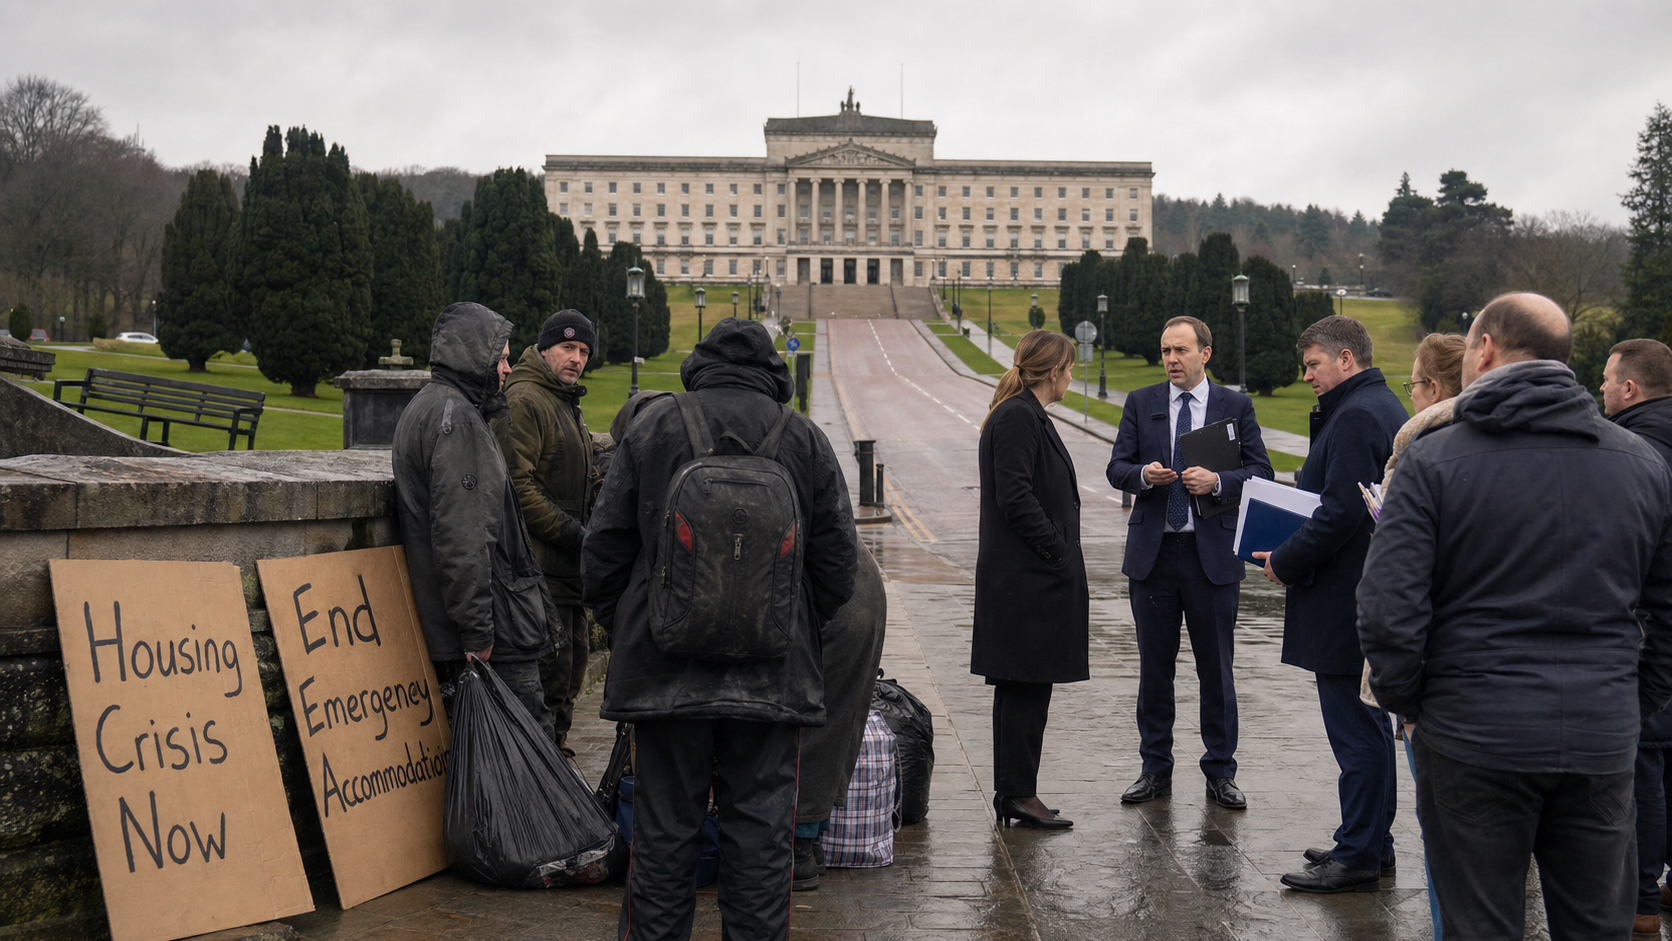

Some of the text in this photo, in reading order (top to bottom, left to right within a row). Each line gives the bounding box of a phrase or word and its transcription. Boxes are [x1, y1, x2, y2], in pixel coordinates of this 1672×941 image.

[83, 600, 243, 698] Housing
[293, 574, 382, 655] End
[96, 704, 228, 774] Crisis
[119, 791, 225, 873] Now
